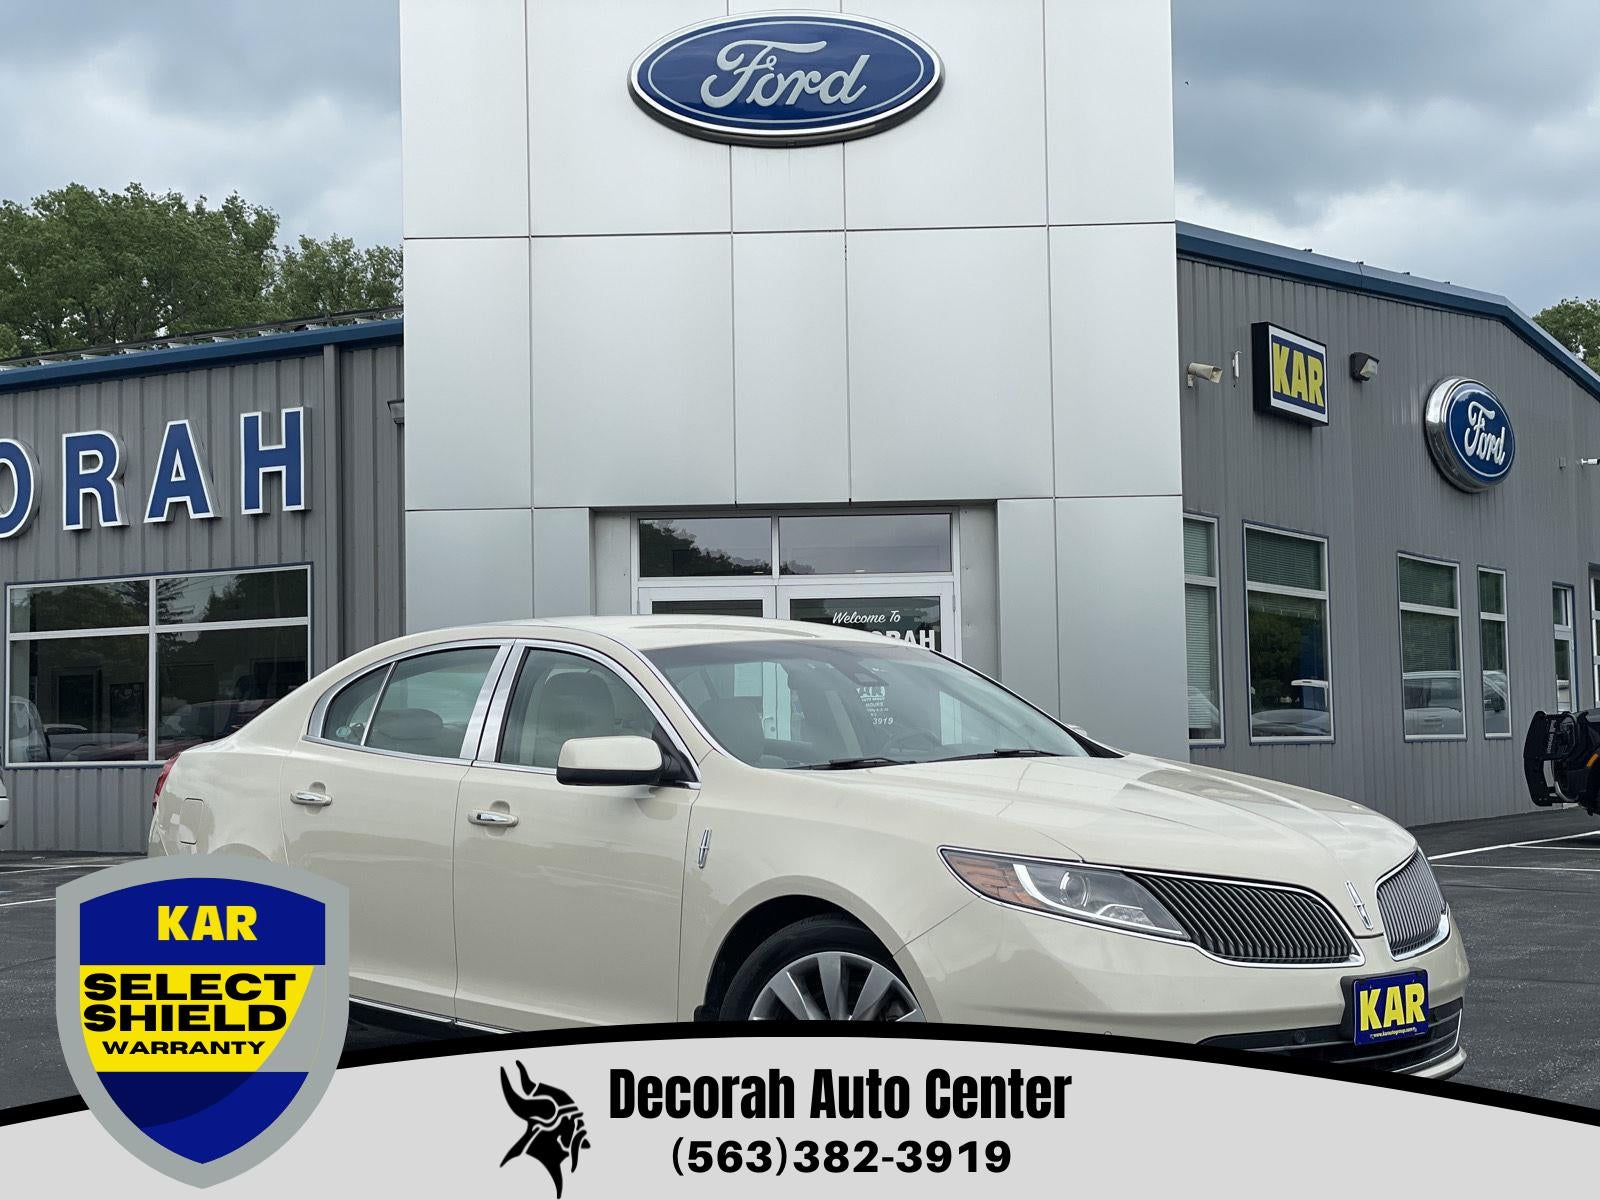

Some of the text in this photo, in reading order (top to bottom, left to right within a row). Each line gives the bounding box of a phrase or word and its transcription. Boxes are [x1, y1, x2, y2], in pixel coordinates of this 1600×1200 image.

[700, 39, 871, 108] Ford
[1272, 342, 1325, 408] KAR
[1464, 400, 1506, 466] Ford
[832, 610, 901, 624] Welcome To
[1359, 982, 1426, 1031] KAR
